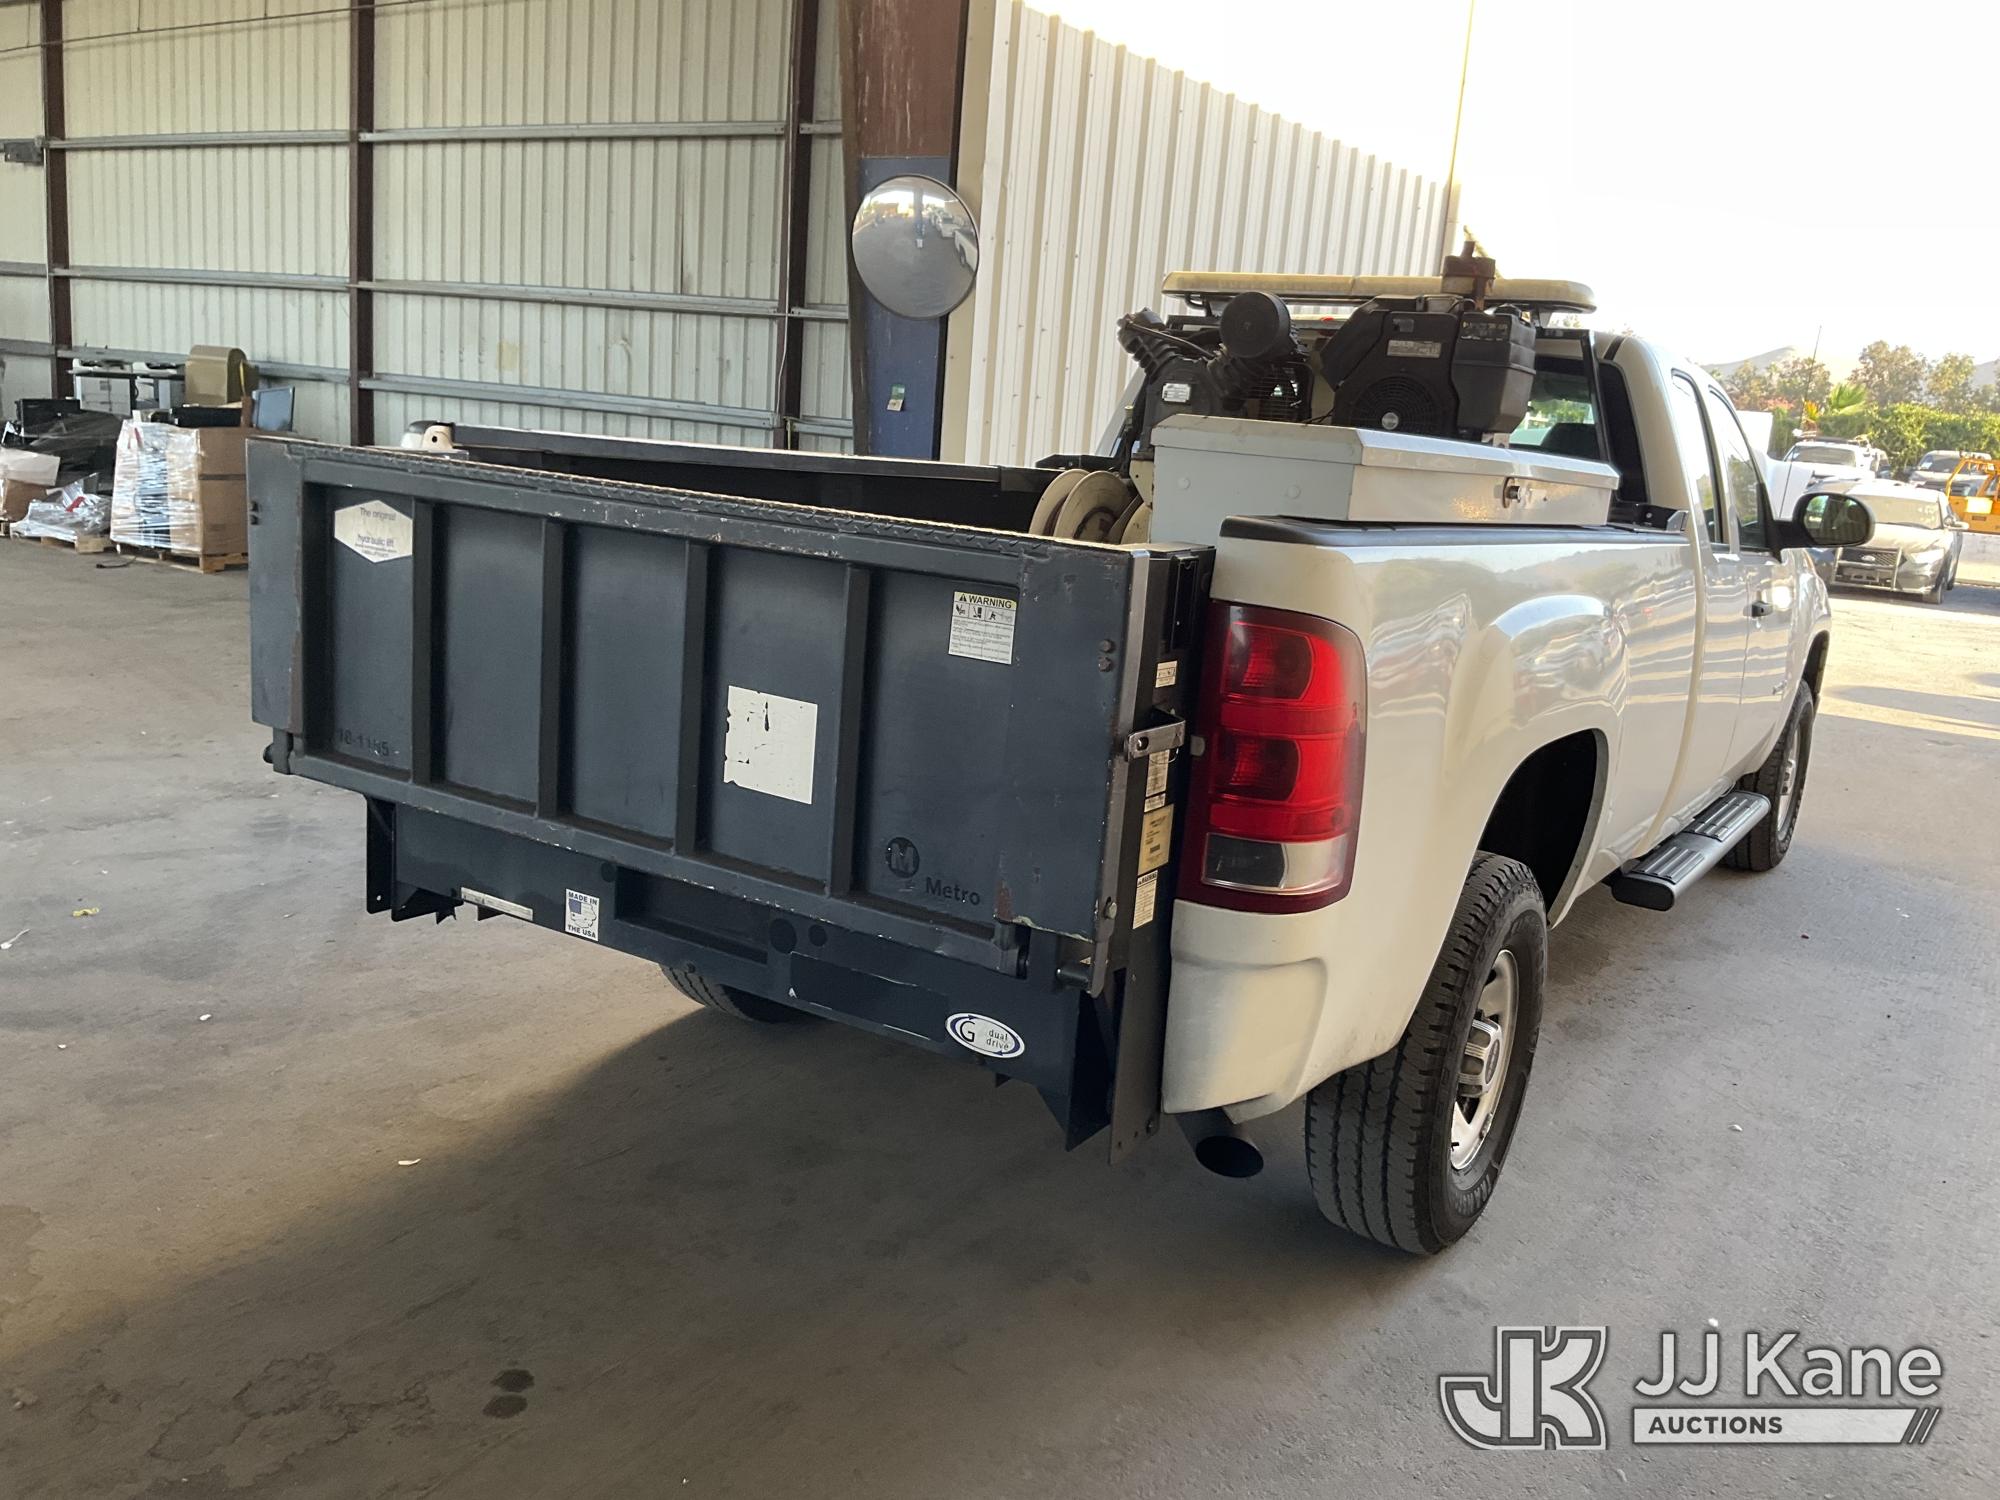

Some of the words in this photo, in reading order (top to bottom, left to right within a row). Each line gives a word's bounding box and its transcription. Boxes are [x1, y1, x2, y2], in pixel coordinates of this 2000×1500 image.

[968, 595, 1012, 609] WARNING
[568, 891, 588, 903] MADE
[589, 897, 598, 905] IN
[925, 877, 981, 906] Metro
[567, 924, 581, 933] THE
[582, 928, 596, 938] USA
[960, 1020, 976, 1043] G
[988, 1029, 1009, 1041] dual
[986, 1038, 1010, 1050] drive
